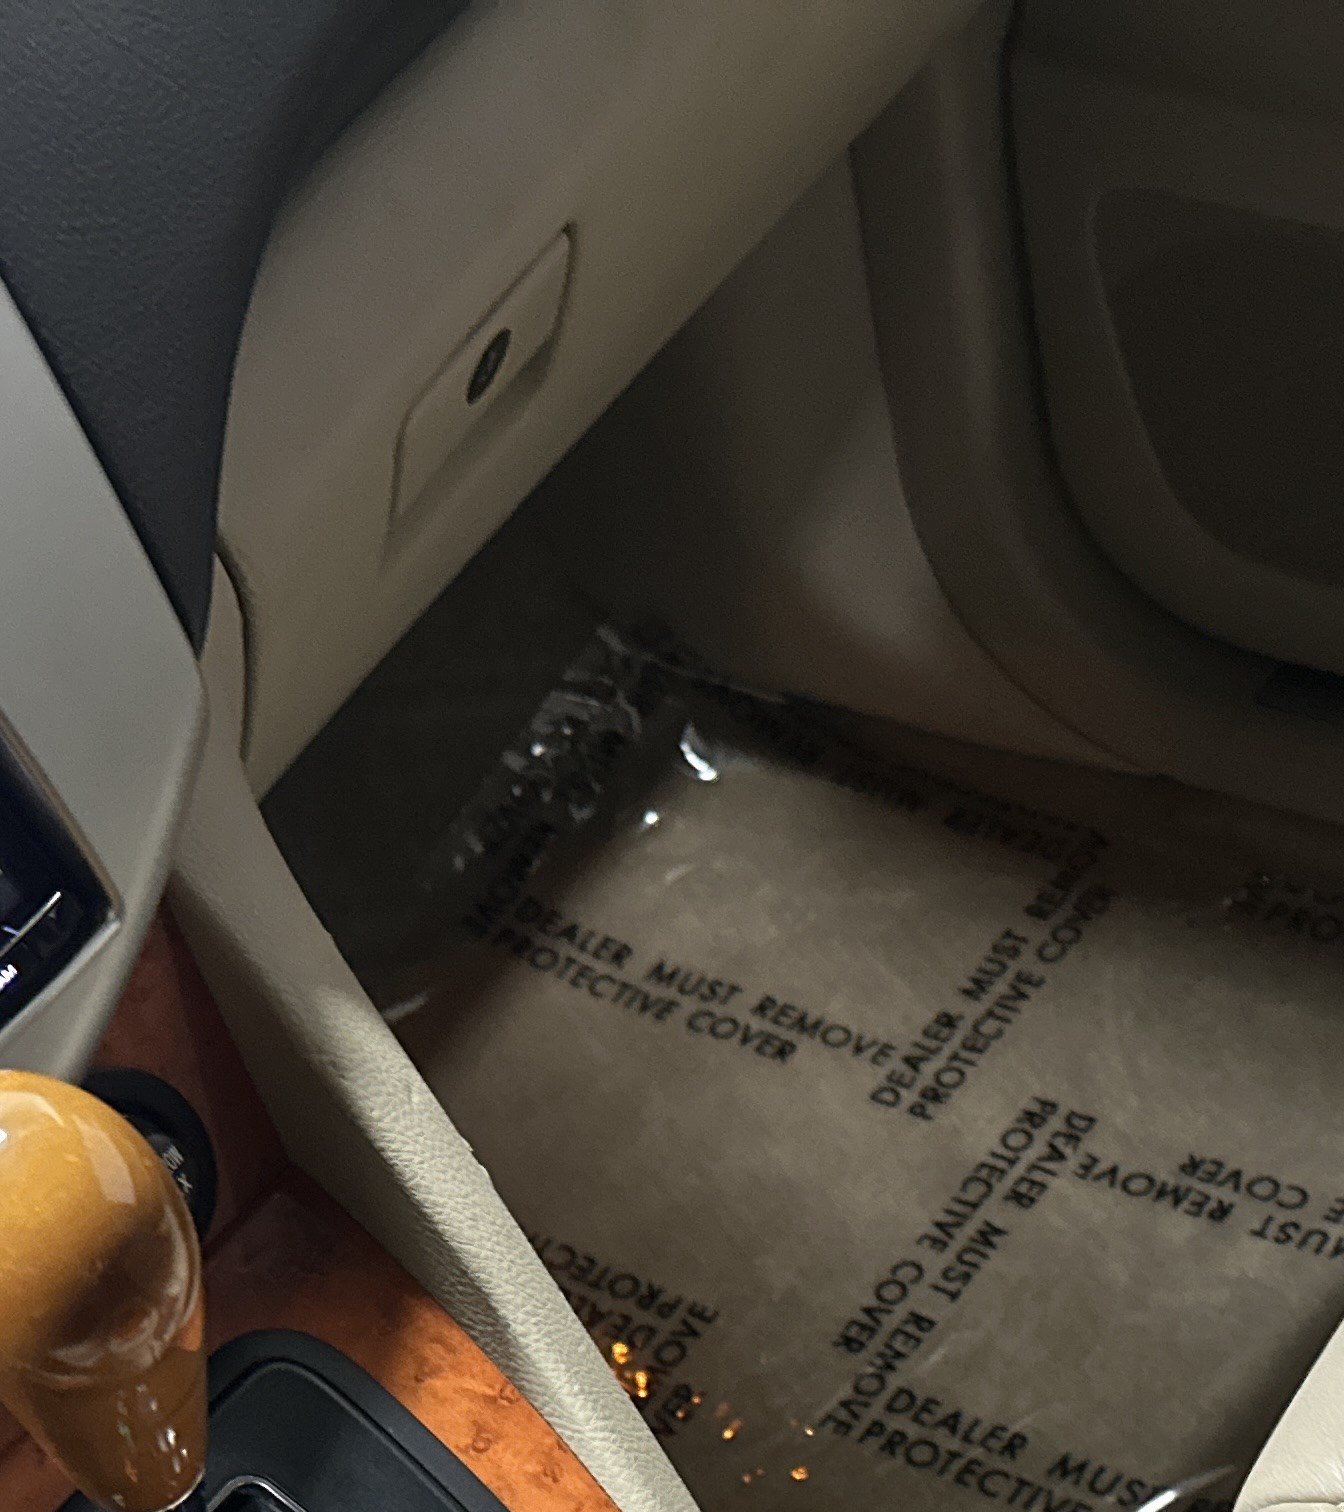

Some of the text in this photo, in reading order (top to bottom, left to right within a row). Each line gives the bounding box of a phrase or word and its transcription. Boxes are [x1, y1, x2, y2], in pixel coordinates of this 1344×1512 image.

[492, 926, 800, 1065] PROTECTIVE COVER
[643, 958, 743, 1007] MUST
[749, 993, 899, 1069] REMOVE
[869, 1009, 966, 1109] DEALER
[957, 926, 1030, 1004] MUST
[907, 967, 1047, 1122] PROTECTIVE
[831, 1095, 1060, 1356] PROTECTIVE COVER
[1070, 1153, 1236, 1227] REMOVE
[1177, 1152, 1311, 1211] COVER
[816, 1107, 1099, 1439] DEALER MUST REMOVE
[882, 1388, 1030, 1463] DEALER
